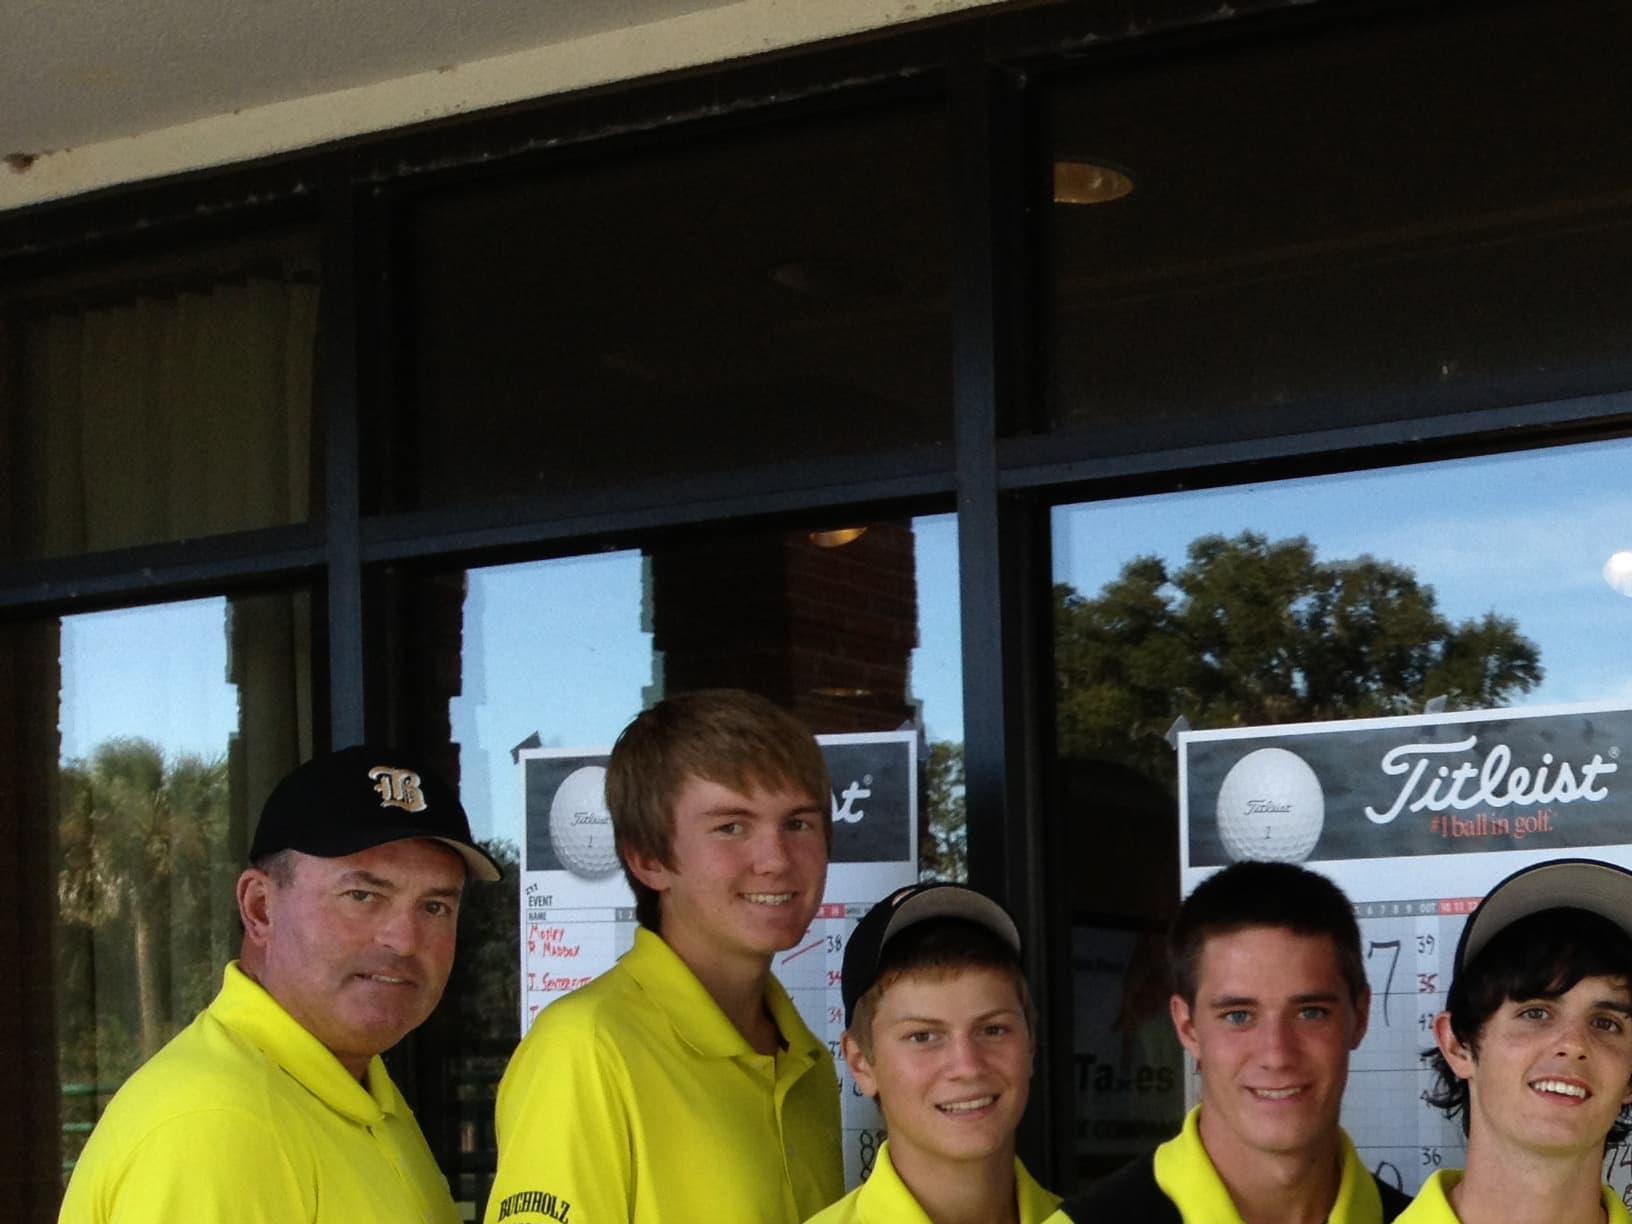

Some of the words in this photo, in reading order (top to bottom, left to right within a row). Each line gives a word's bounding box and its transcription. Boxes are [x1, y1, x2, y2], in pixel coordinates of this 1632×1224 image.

[1365, 735, 1617, 824] Titleist
[1452, 812, 1487, 837] ball
[1491, 811, 1508, 835] in
[528, 896, 553, 907] EVENT
[827, 935, 842, 953] 38
[1416, 935, 1435, 955] 39
[1422, 1149, 1442, 1165] 36
